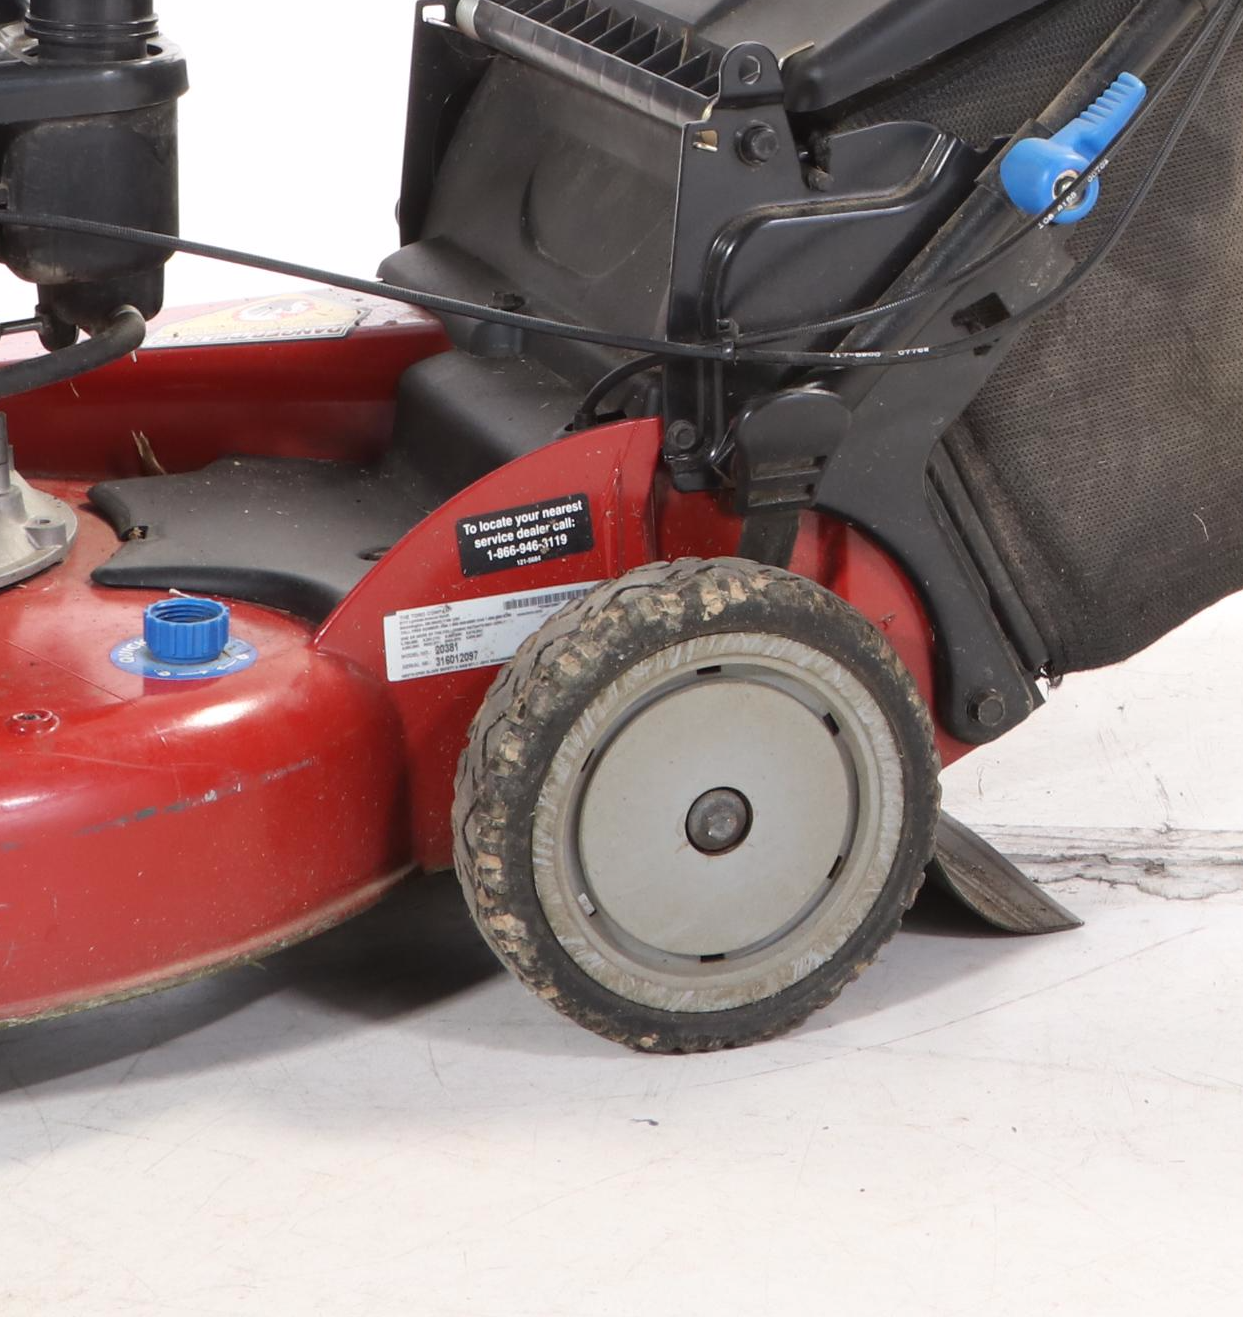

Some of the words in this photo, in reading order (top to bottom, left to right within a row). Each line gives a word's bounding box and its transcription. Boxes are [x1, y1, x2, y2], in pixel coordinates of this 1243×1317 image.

[463, 523, 477, 536] To
[479, 516, 513, 532] locate
[515, 511, 540, 527] your
[542, 500, 583, 519] nearest
[474, 532, 514, 549] service
[516, 524, 551, 540] dealer
[552, 517, 576, 532] call:
[487, 533, 568, 561] 1-866-946-3119
[435, 643, 459, 655] 20381
